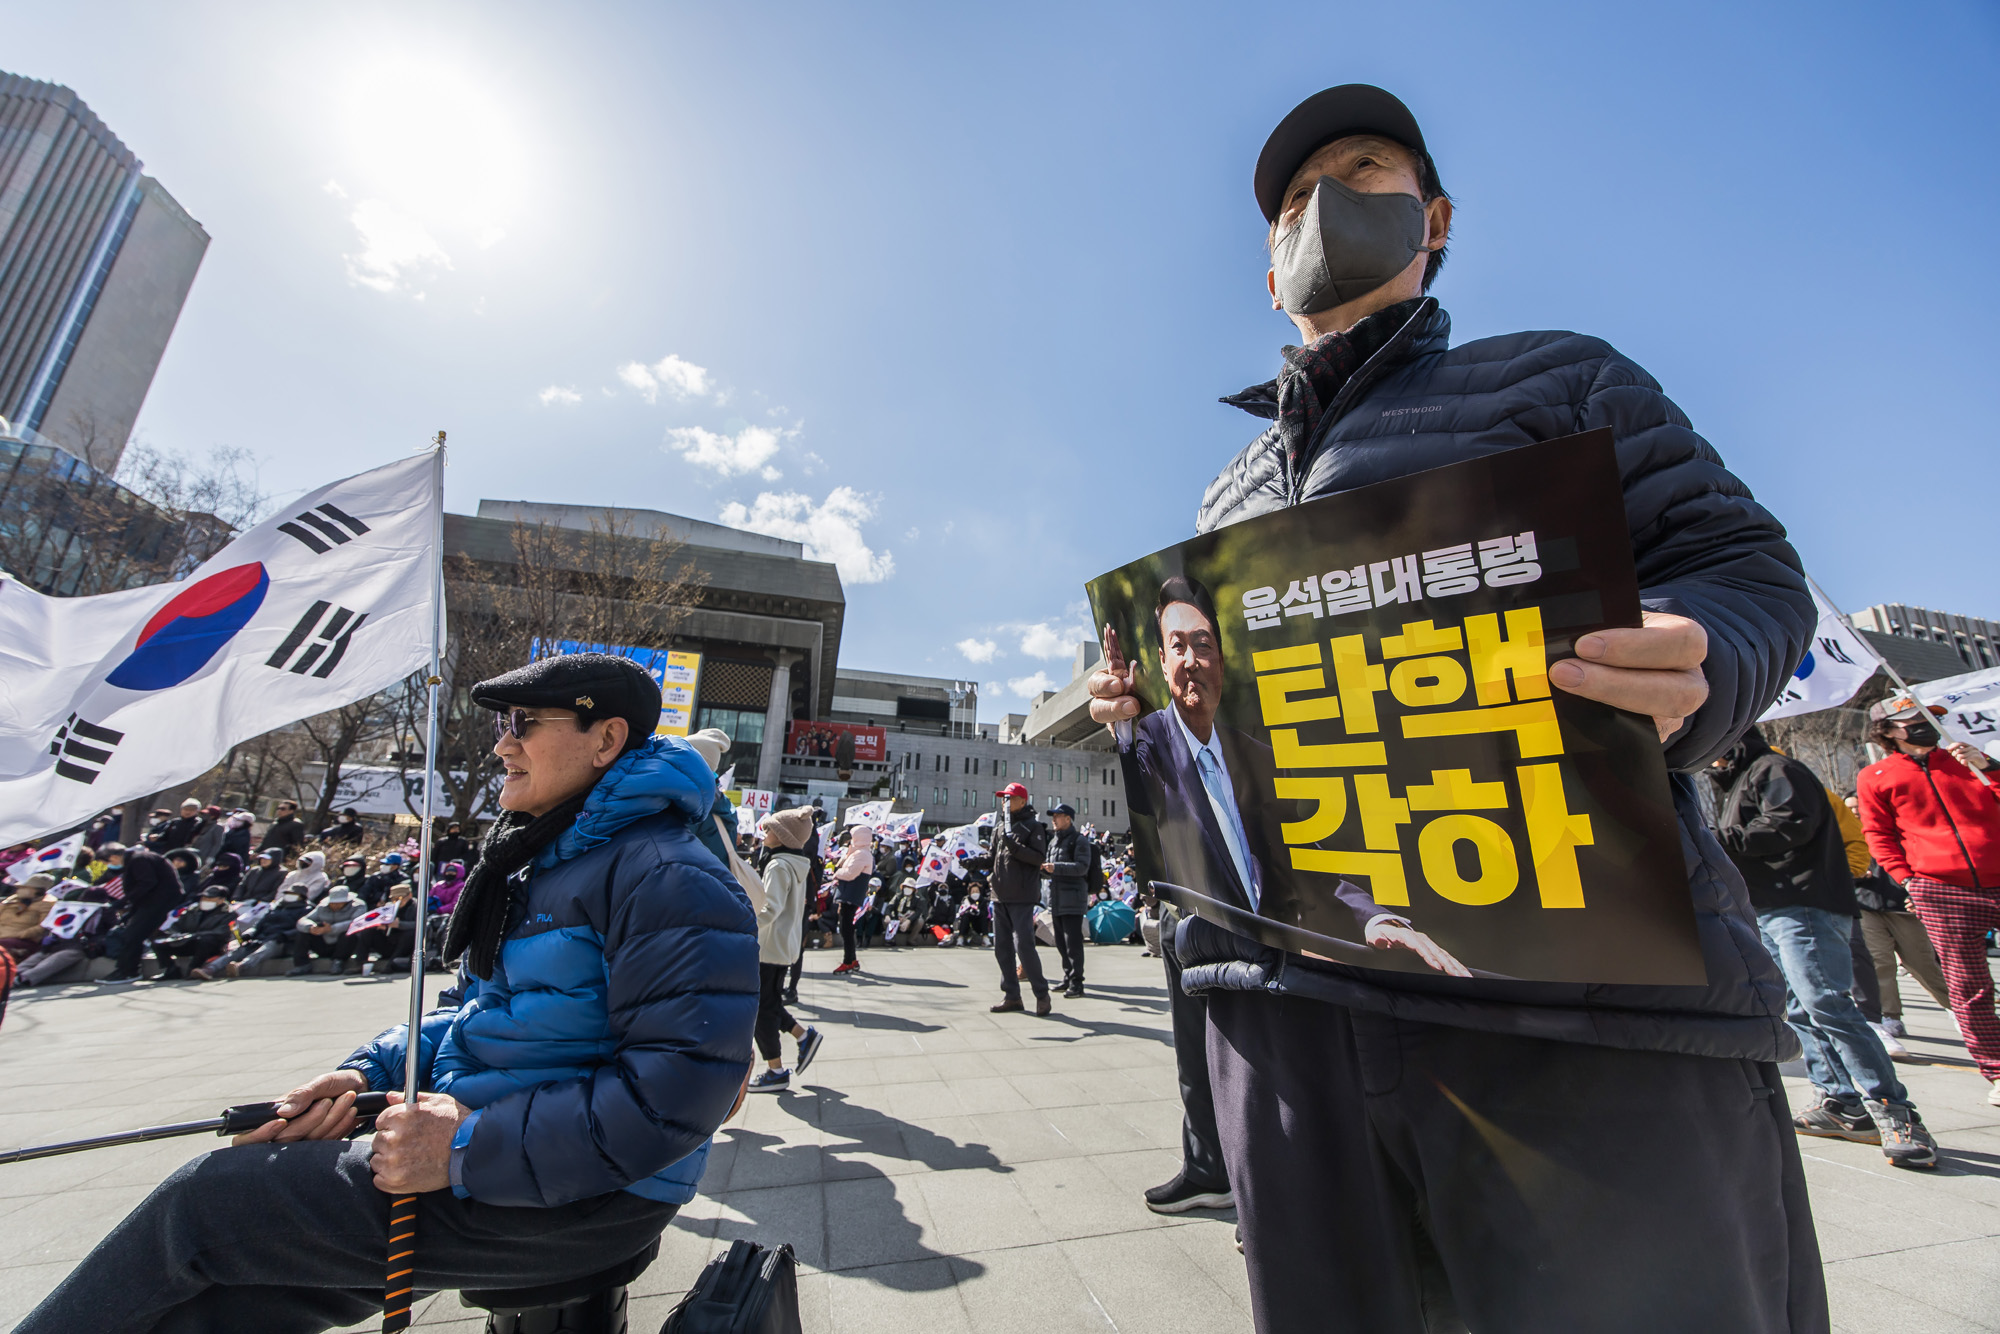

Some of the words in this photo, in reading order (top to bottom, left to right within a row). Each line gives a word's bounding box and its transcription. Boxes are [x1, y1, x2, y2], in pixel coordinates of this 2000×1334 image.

[1381, 405, 1442, 418] WESTWOOD
[1241, 531, 1542, 631] 윤석열대통령
[1252, 605, 1566, 769] 탄핵
[1273, 761, 1596, 909] 각하
[537, 913, 553, 923] FILA
